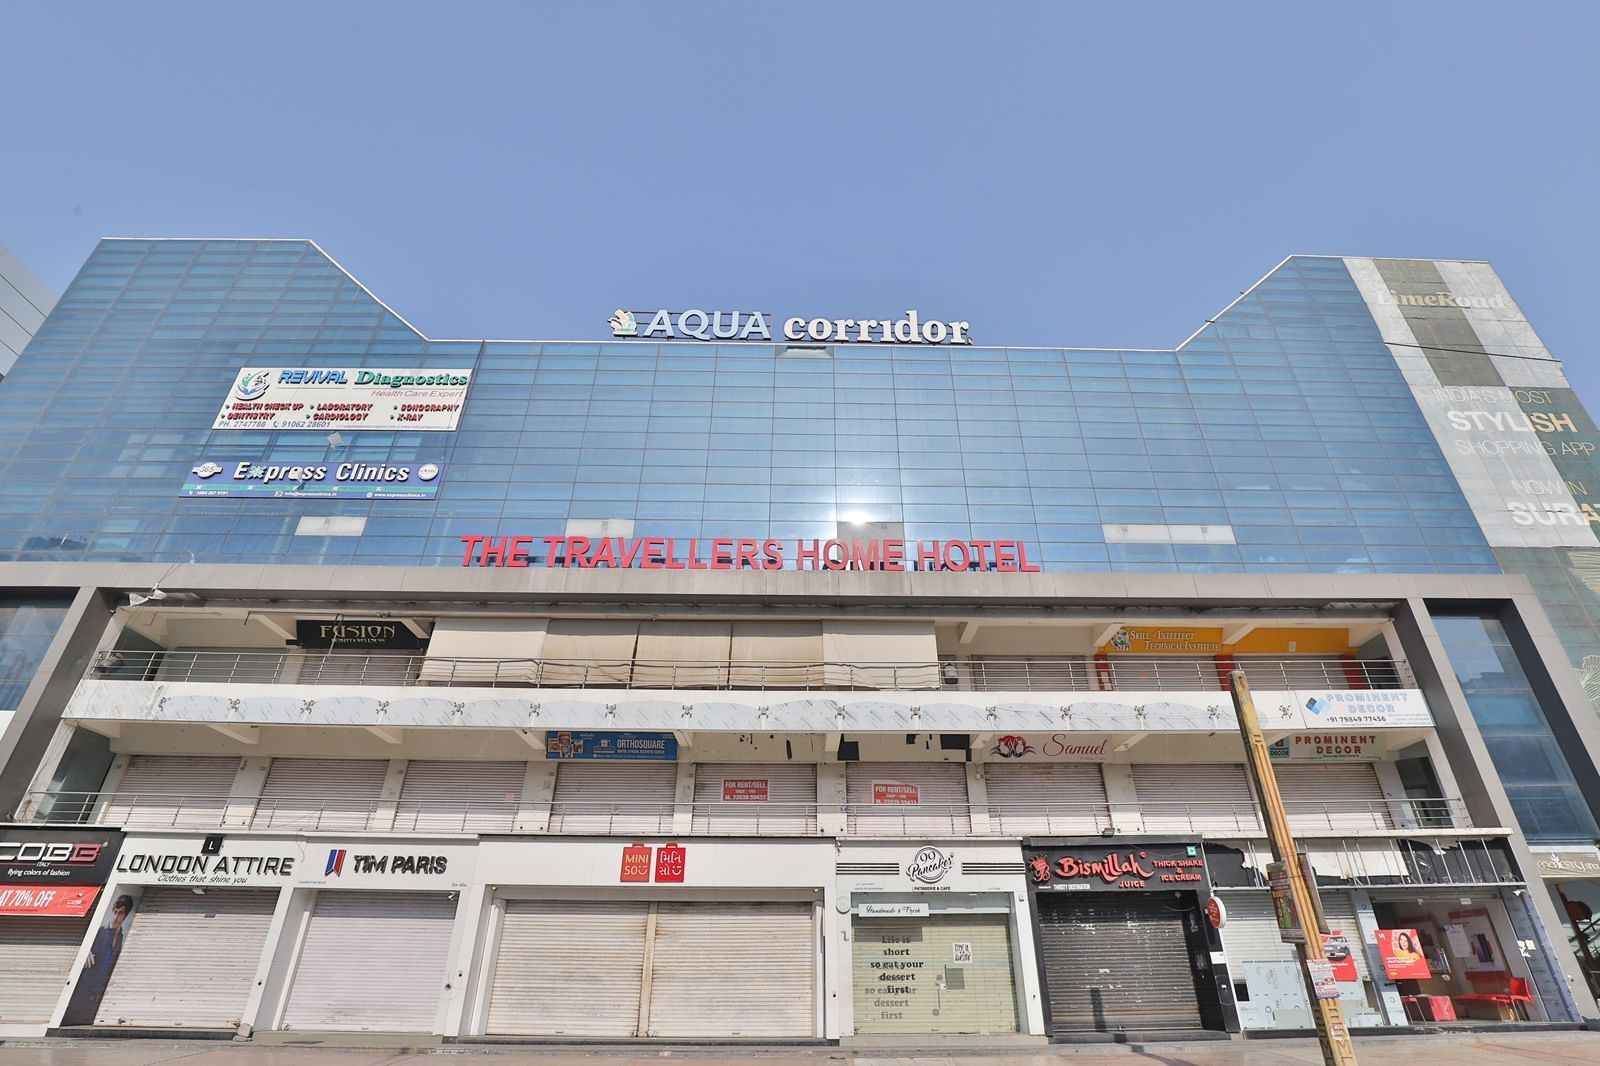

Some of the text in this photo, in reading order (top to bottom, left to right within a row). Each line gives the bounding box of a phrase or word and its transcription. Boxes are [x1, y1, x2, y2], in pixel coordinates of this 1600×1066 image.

[642, 309, 970, 344] AQUA corridor
[278, 370, 468, 388] REVIVAL Diagnostics
[429, 390, 464, 398] Expert
[1432, 388, 1553, 404] INDIA'S MOST
[316, 403, 373, 411] LABORATORY
[400, 404, 460, 412] SONOGRAPHY
[313, 413, 368, 421] CARDIOLOGY
[397, 413, 423, 421] X-RAY
[1446, 410, 1578, 433] STYLISH
[1455, 440, 1596, 456] SHOPPING APP
[233, 462, 410, 485] Express Clinics
[1511, 479, 1588, 496] NOW IN
[460, 535, 1042, 573] THE TRAVELLERS HOME HOTEL
[320, 624, 396, 638] FUSION
[1326, 692, 1408, 702] PROMINENT
[1348, 704, 1396, 713] DECOR
[617, 739, 665, 749] ORTHOSQUARE
[1043, 733, 1108, 757] Samuel
[1295, 735, 1377, 745] PROMINENT
[1316, 745, 1362, 754] DECOR
[625, 854, 649, 863] MINI
[920, 850, 936, 863] 99
[116, 854, 295, 876] LONDON ATTIRE
[353, 855, 448, 874] TIM PARIS
[1055, 852, 1155, 883] Bismillah
[1153, 860, 1177, 868] THICK
[8, 868, 22, 877] flying
[1160, 873, 1202, 882] ICE CREAM
[157, 874, 186, 883] Clothes
[189, 875, 206, 883] that
[233, 877, 248, 885] you
[1119, 880, 1146, 888] JUICE
[0, 889, 56, 907] AT 70% OFF
[865, 905, 896, 914] Handmade
[902, 906, 920, 914] Fresh
[900, 961, 924, 969] your
[887, 985, 909, 993] first
